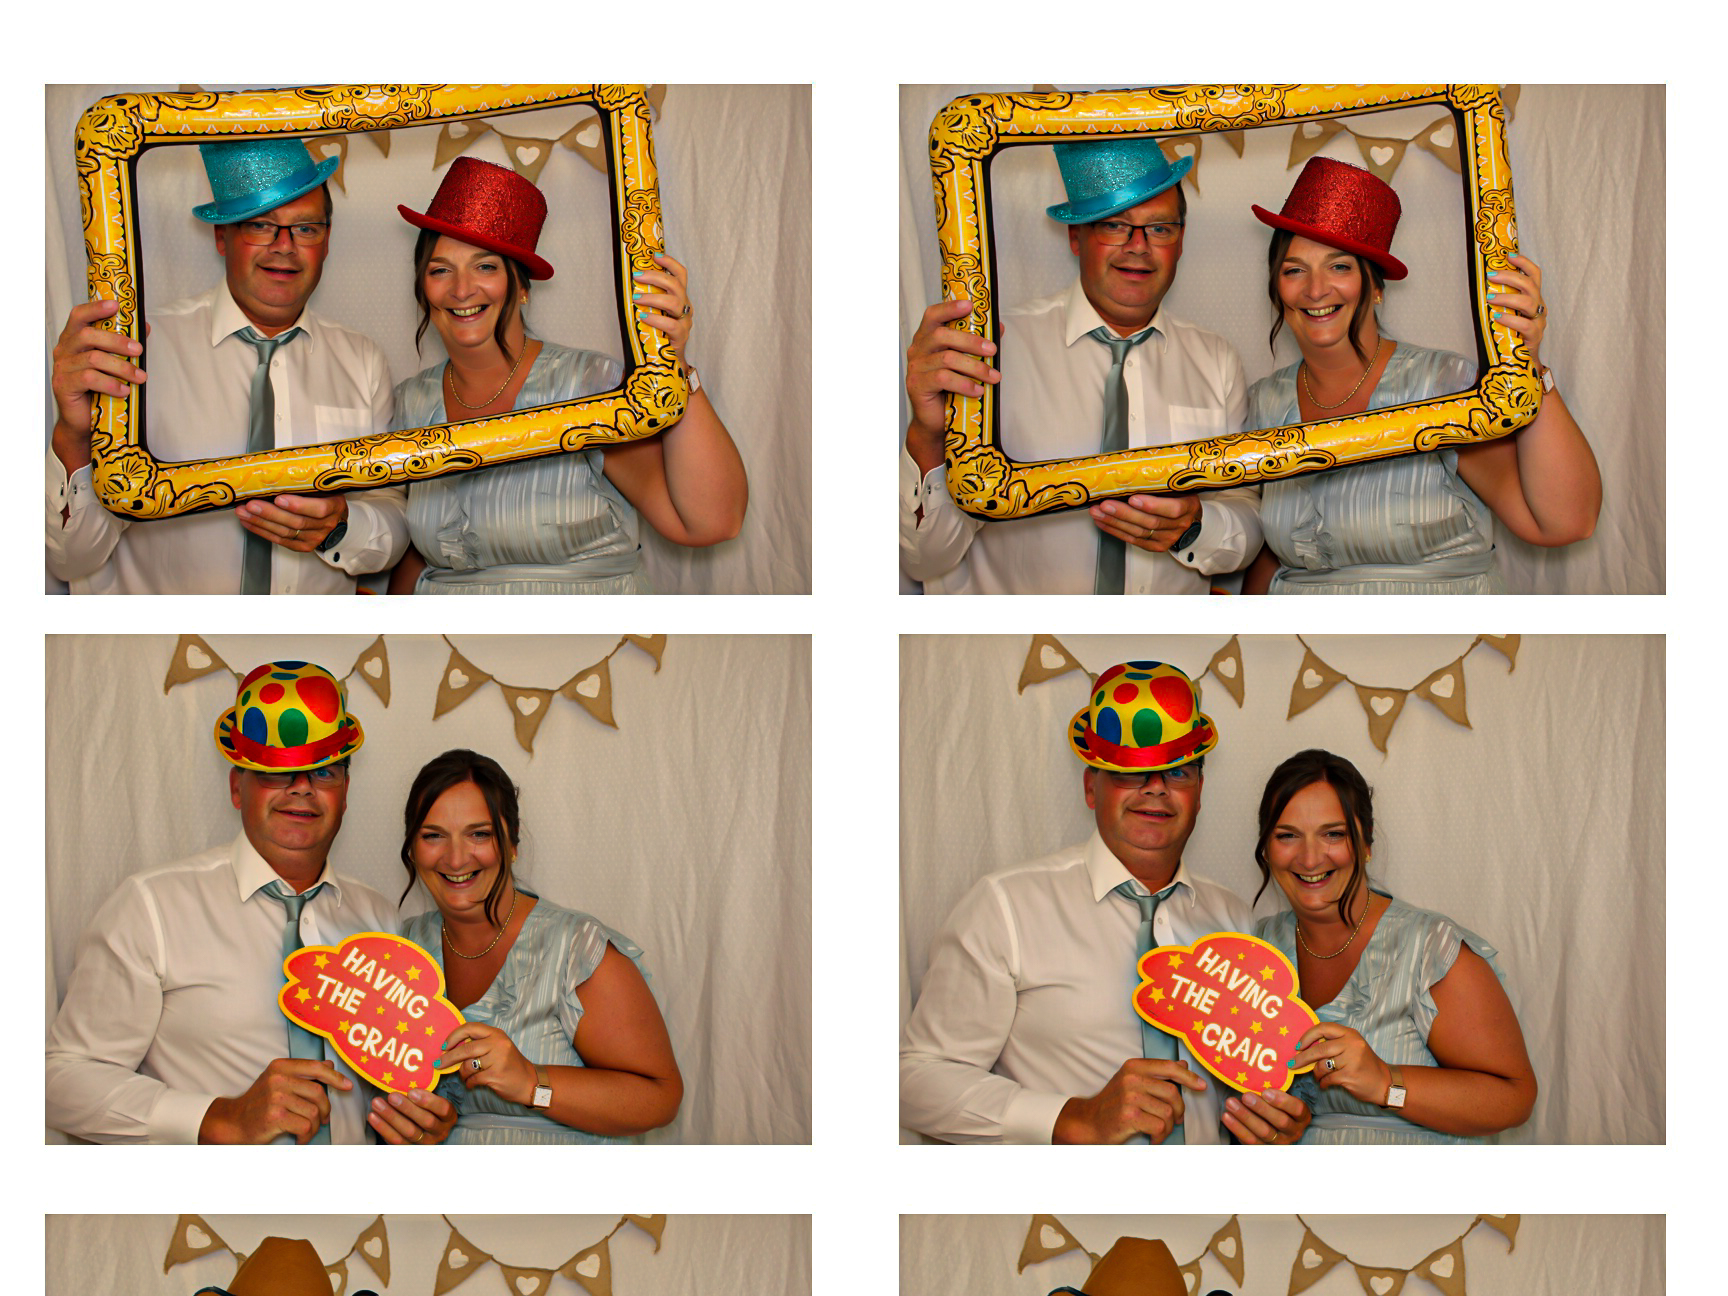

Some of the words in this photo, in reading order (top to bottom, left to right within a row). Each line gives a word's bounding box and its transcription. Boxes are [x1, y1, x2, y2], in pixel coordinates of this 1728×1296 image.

[316, 974, 366, 1015] THE
[342, 947, 429, 1019] HAVING
[1170, 974, 1220, 1015] THE
[1196, 947, 1283, 1019] HAVING
[347, 1023, 423, 1072] CRAIC
[1201, 1023, 1277, 1072] CRAIC
